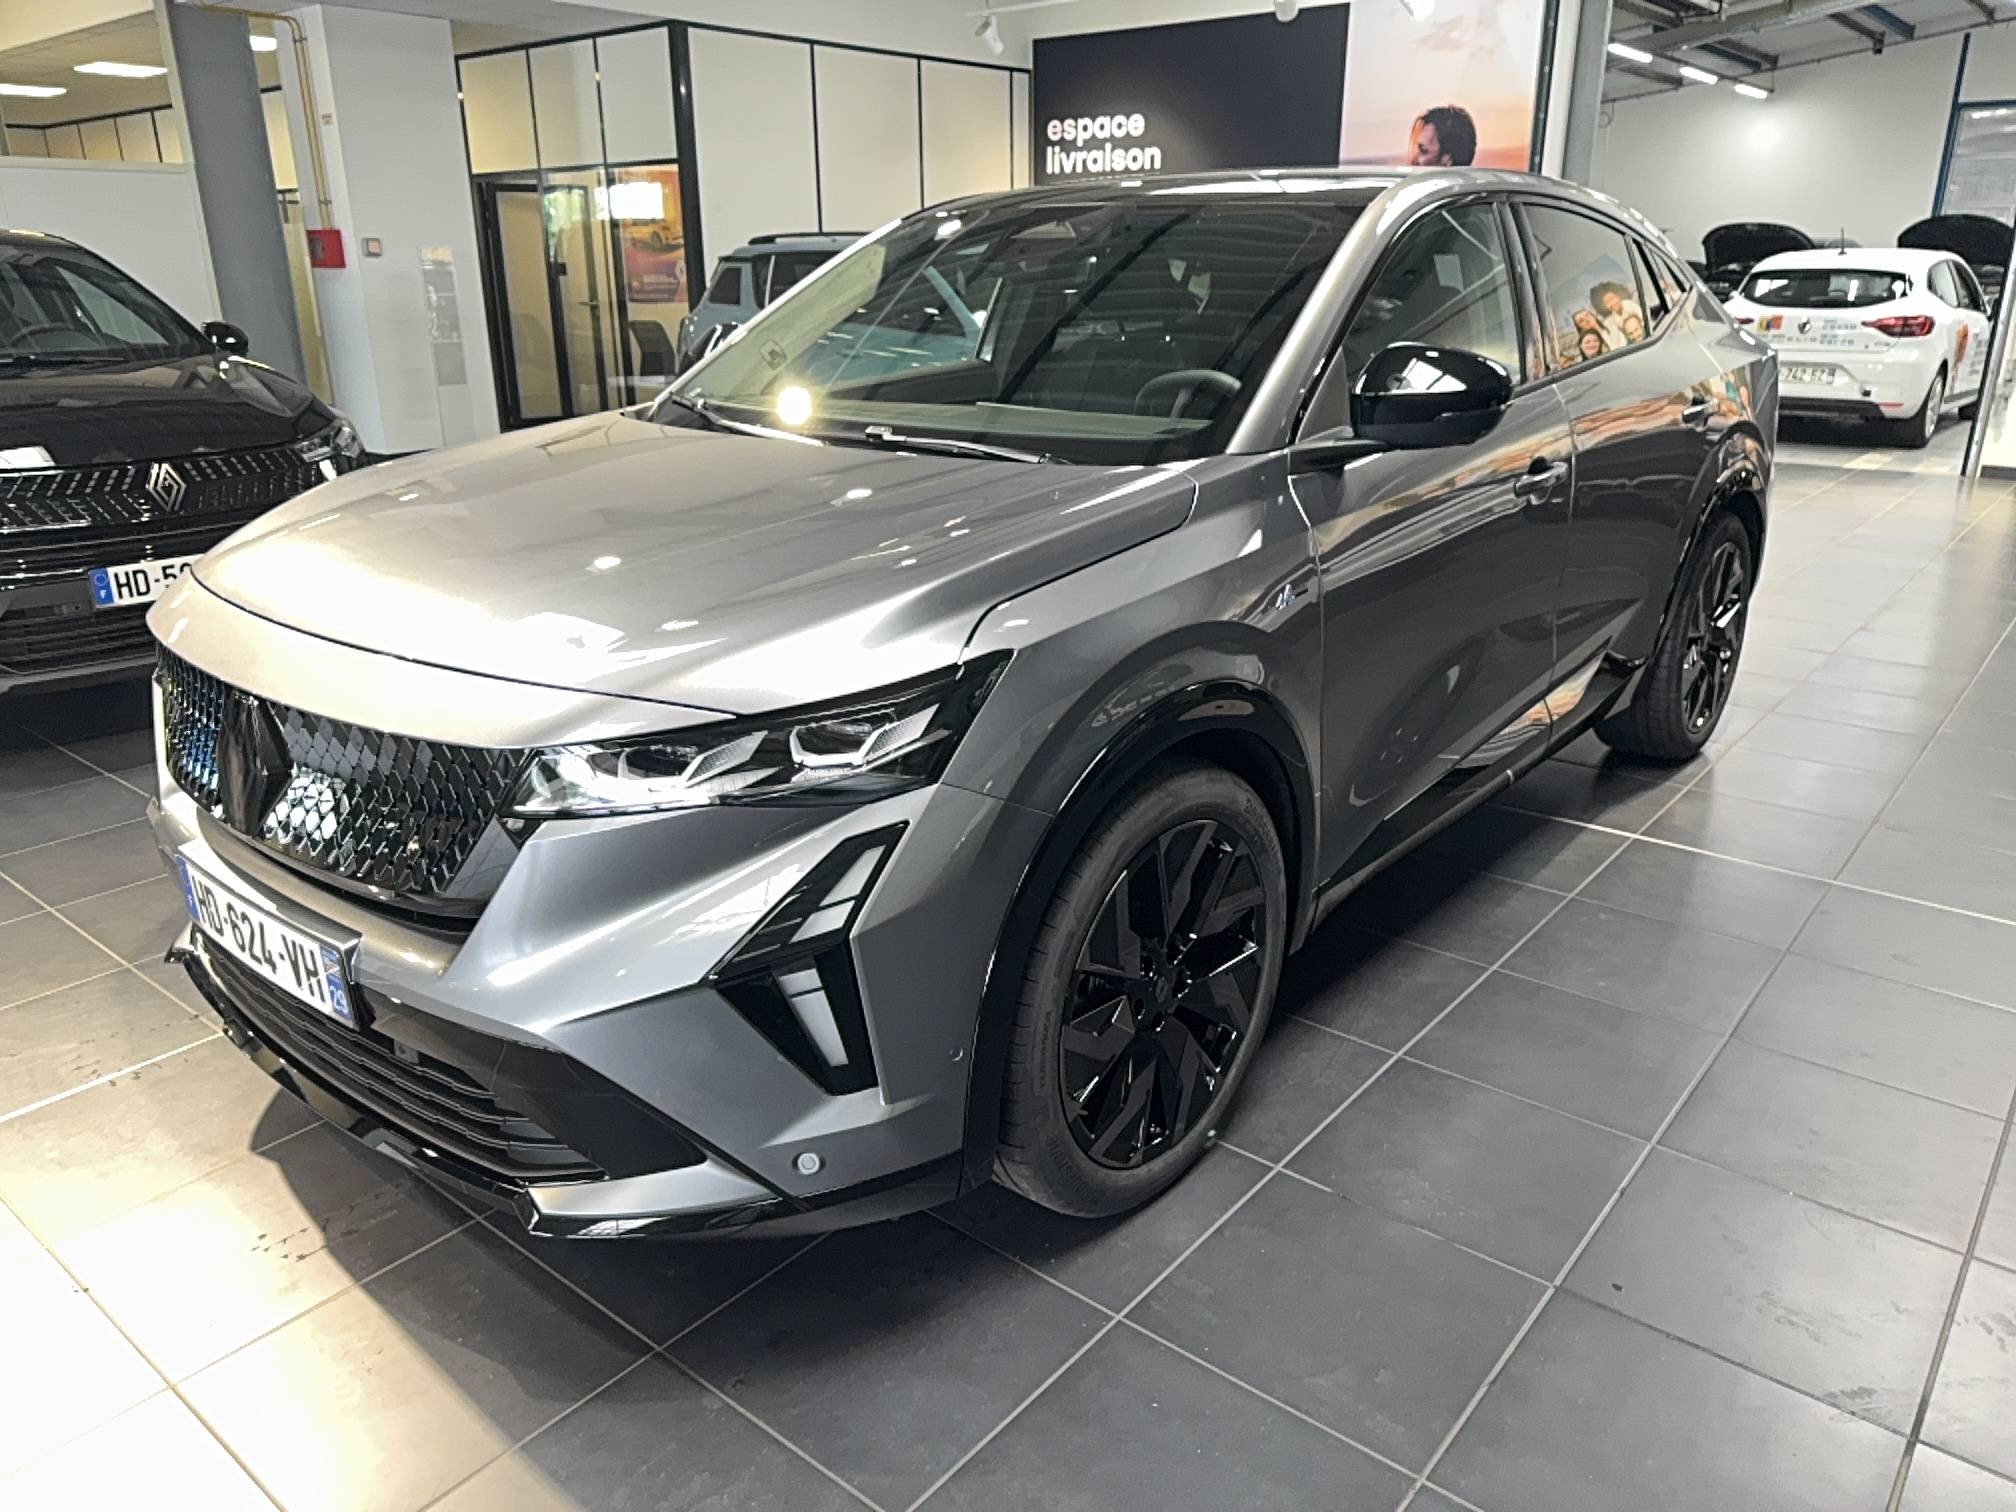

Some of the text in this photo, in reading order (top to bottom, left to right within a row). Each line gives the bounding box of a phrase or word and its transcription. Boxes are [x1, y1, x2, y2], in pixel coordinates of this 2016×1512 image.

[1047, 113, 1145, 147] espace
[1046, 142, 1162, 175] livraison
[191, 875, 325, 1003] HD-624-VH
[330, 984, 350, 1015] 29
